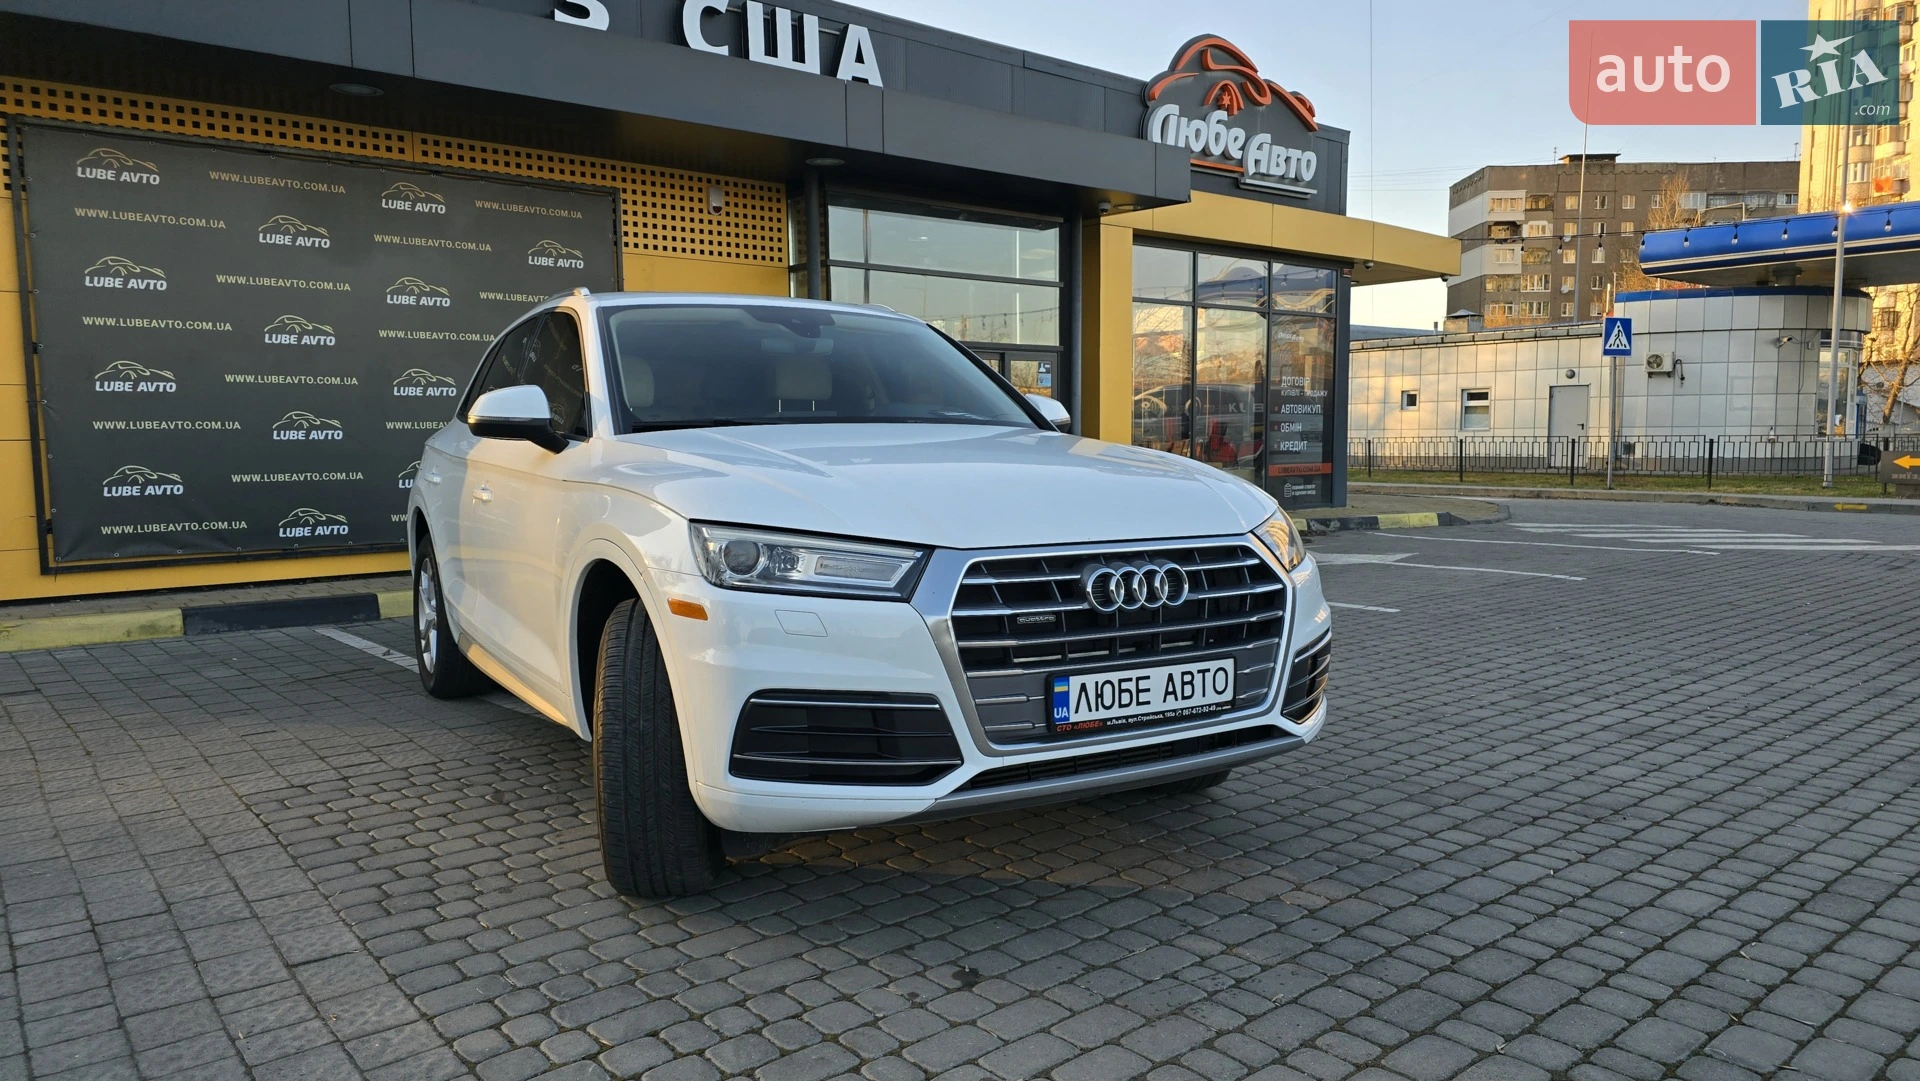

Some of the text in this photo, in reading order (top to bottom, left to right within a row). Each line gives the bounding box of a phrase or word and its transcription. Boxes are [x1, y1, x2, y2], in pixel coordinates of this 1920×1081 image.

[683, 0, 883, 88] США
[1148, 103, 1317, 182] Любе Авто
[76, 166, 160, 185] LUBE AVTO
[209, 171, 346, 193] WWW.LUBEAVTO.COM.UA
[381, 198, 446, 215] LUBE AVTO
[475, 200, 583, 219] WWW.LUBEAVTO.COM.UA
[75, 207, 227, 229] WWW.LUBEAVTO.COM.UA
[259, 232, 330, 248] LUBE AVTO
[374, 234, 492, 252] WWW.LUBEAVTO.COM.UA
[528, 255, 584, 269] LUBE AVTO
[85, 276, 168, 291] LUBE AVTO
[217, 275, 352, 292] WWW.LUBEAVTO.COM.UA
[387, 293, 451, 307] LUBE AVTO
[82, 317, 233, 331] WWW.LUBEAVTO.COM.UA
[265, 334, 336, 346] LUBE AVTO
[378, 329, 497, 343] WWW.LUBEAVTO.COM.UA
[225, 373, 359, 385] WWW.LUBEAVTO.COM.UA
[1281, 376, 1311, 387] ДОГОВІР
[95, 381, 177, 392] LUBE AVTO
[393, 386, 457, 396] LUBE AVTO
[1281, 404, 1321, 414] АВТОВИКУП
[93, 420, 242, 430] WWW.LUBEAVTO.COM.UA
[1280, 422, 1302, 432] ОБМІН
[273, 430, 343, 440] LUBE AVTO
[1280, 440, 1308, 452] КРЕДИТ
[231, 471, 364, 483] WWW.LUBEAVTO.COM.UA
[103, 484, 184, 497] LUBE AVTO
[101, 520, 248, 535] WWW.LUBEAVTO.COM.UA
[279, 525, 349, 537] LUBE AVTO
[1074, 665, 1230, 715] ЛЮБЕ АВТО
[1053, 707, 1069, 719] UA
[1056, 720, 1104, 732] СТО «ЛЮБЕ»
